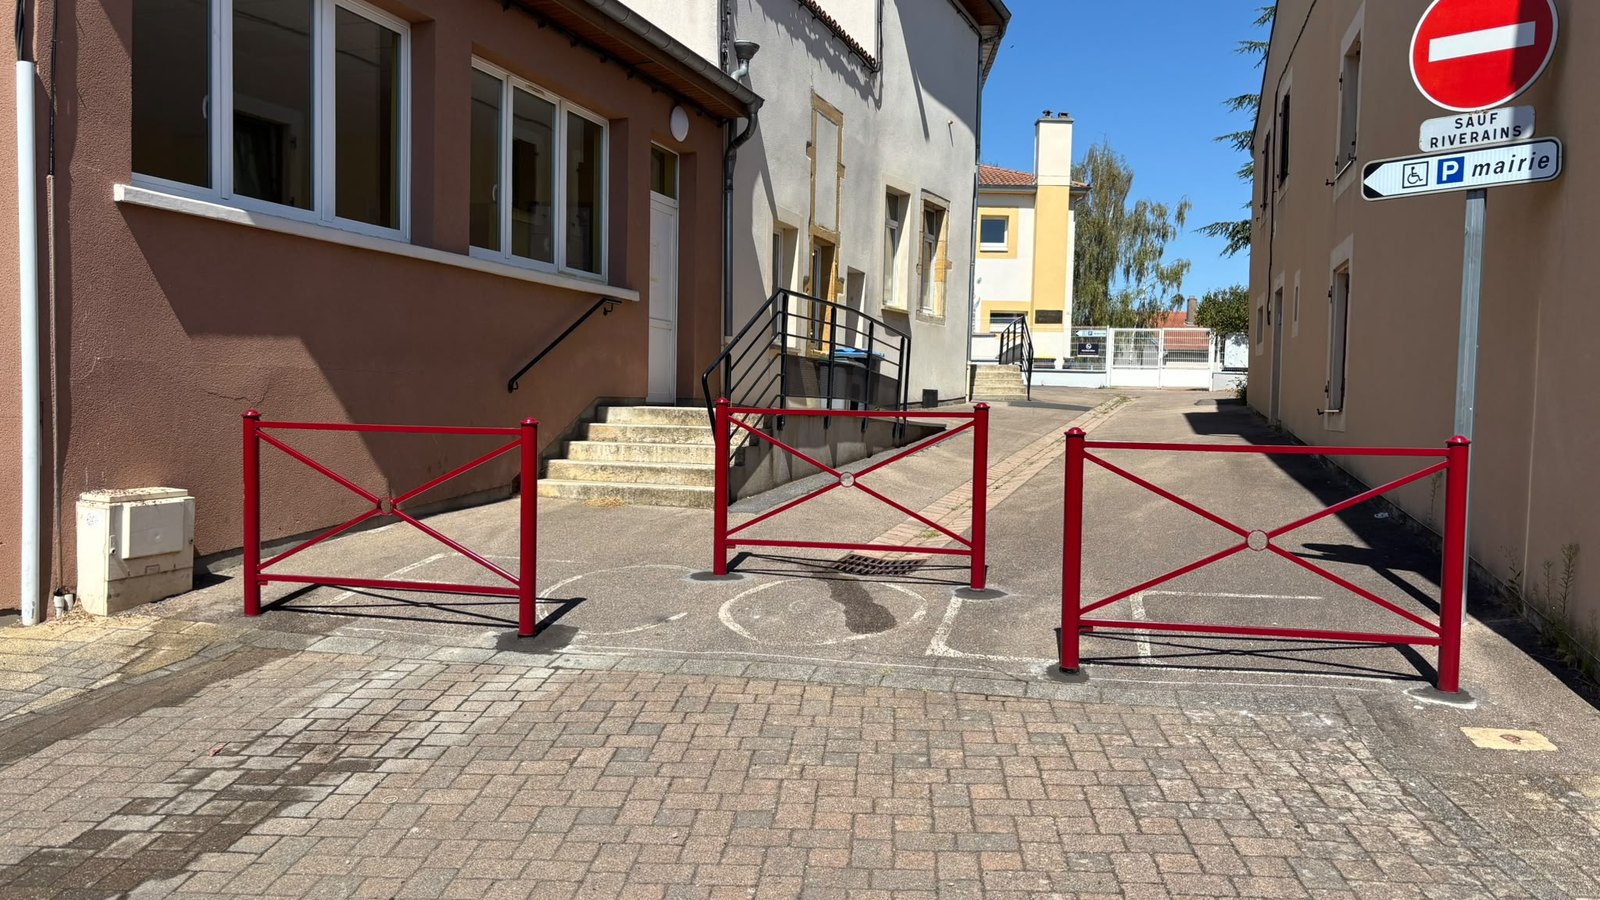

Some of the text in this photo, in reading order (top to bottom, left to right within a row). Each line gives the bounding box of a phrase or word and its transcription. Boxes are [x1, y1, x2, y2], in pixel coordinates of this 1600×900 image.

[1454, 112, 1499, 130] SAUF
[1430, 125, 1522, 148] RIVERAINS
[1442, 152, 1550, 182] P mairie
